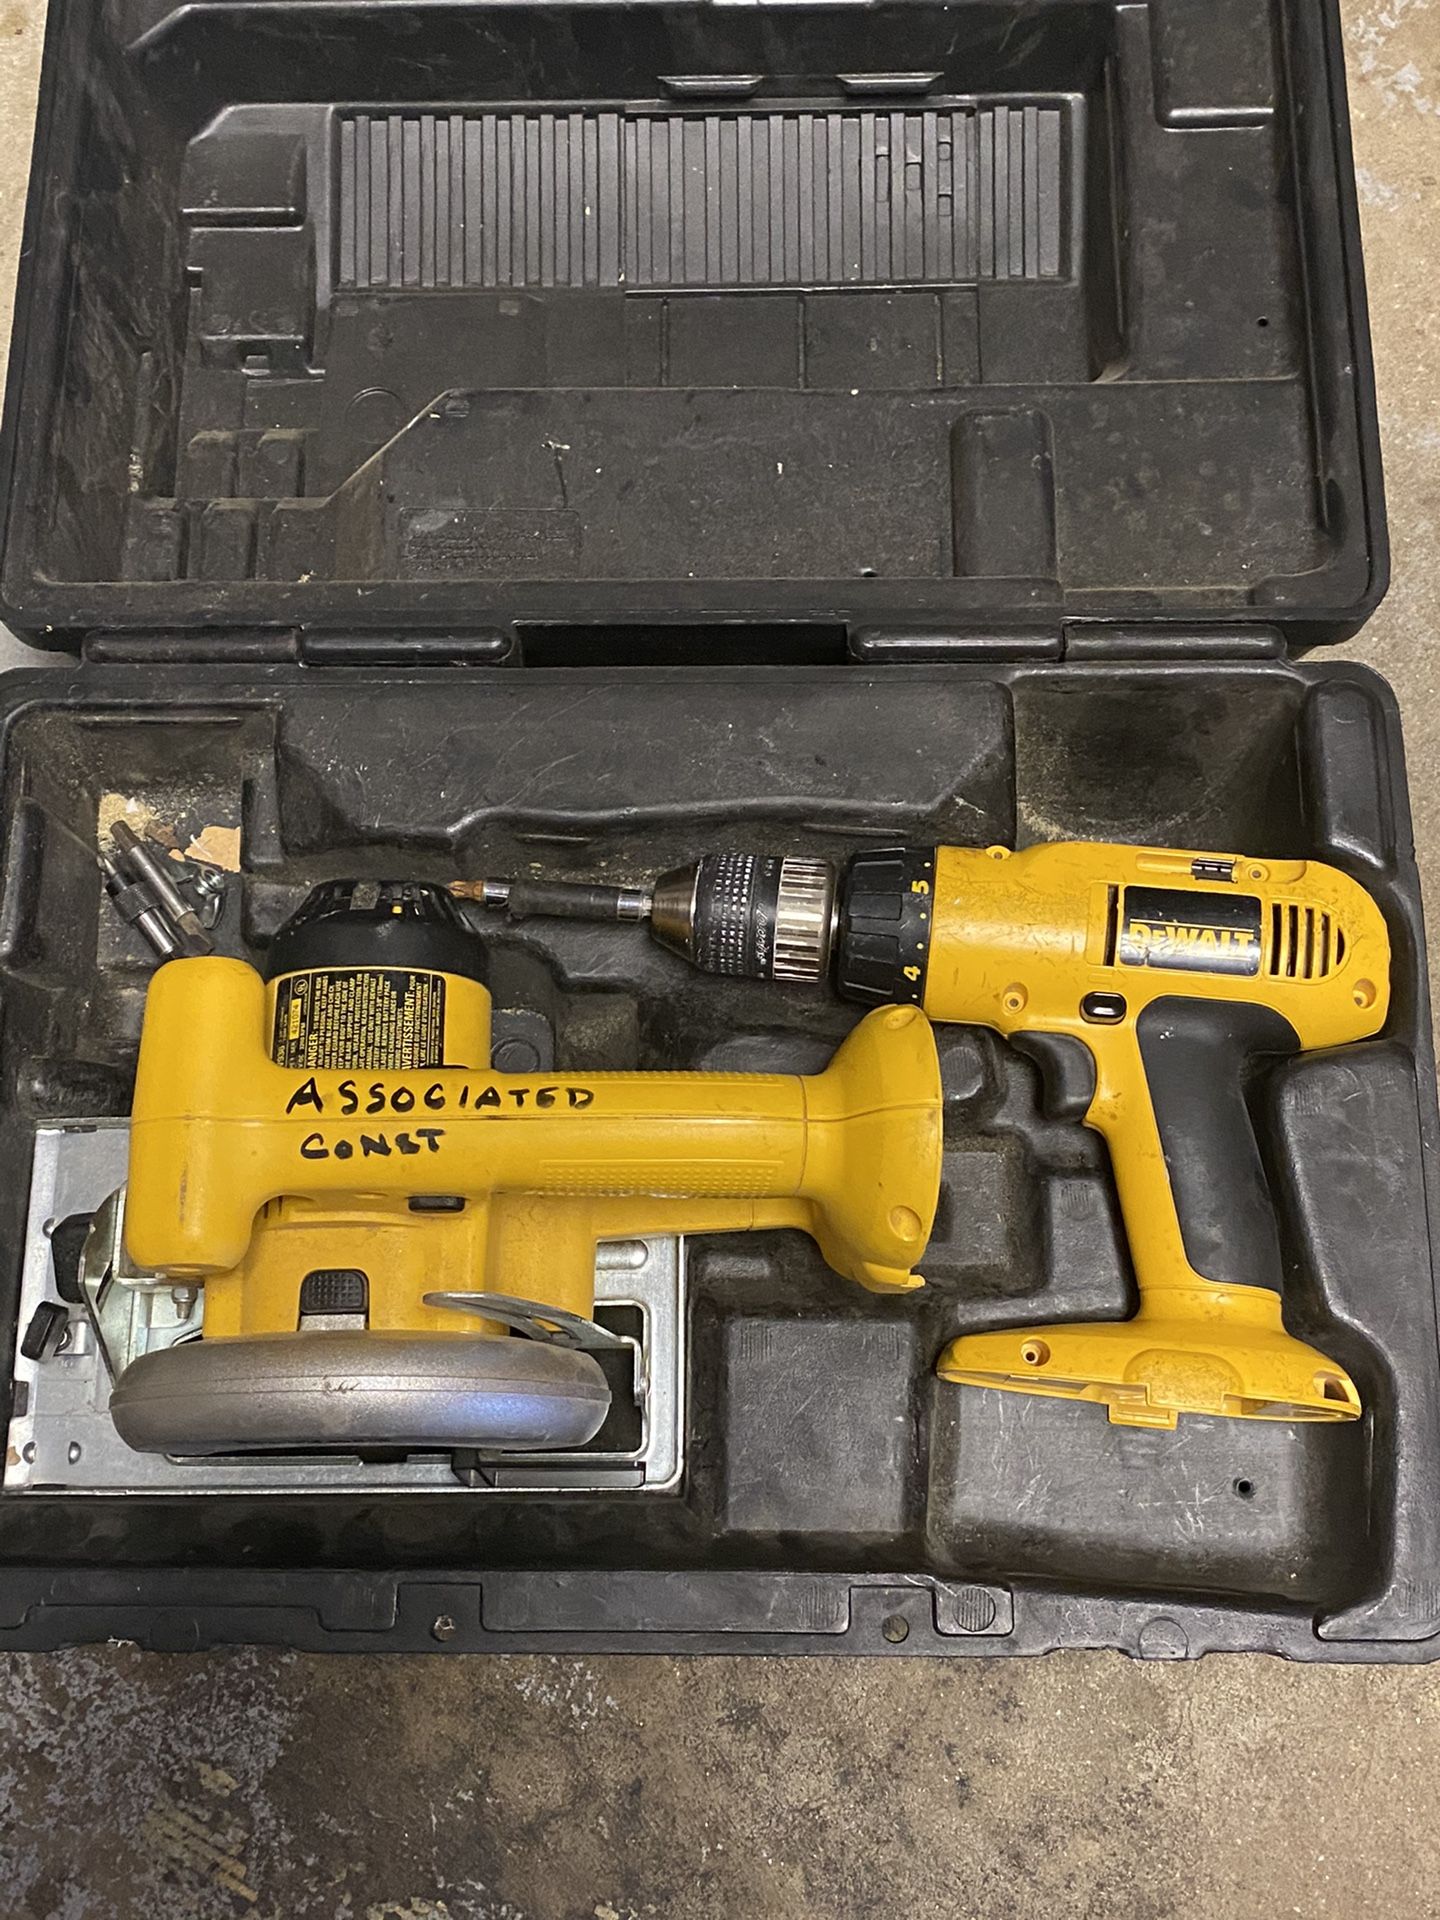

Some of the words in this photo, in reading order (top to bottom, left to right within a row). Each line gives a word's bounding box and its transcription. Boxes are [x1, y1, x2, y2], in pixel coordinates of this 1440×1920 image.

[911, 880, 929, 895] 5
[903, 965, 921, 982] 4
[285, 1076, 595, 1116] ASSOCIATED
